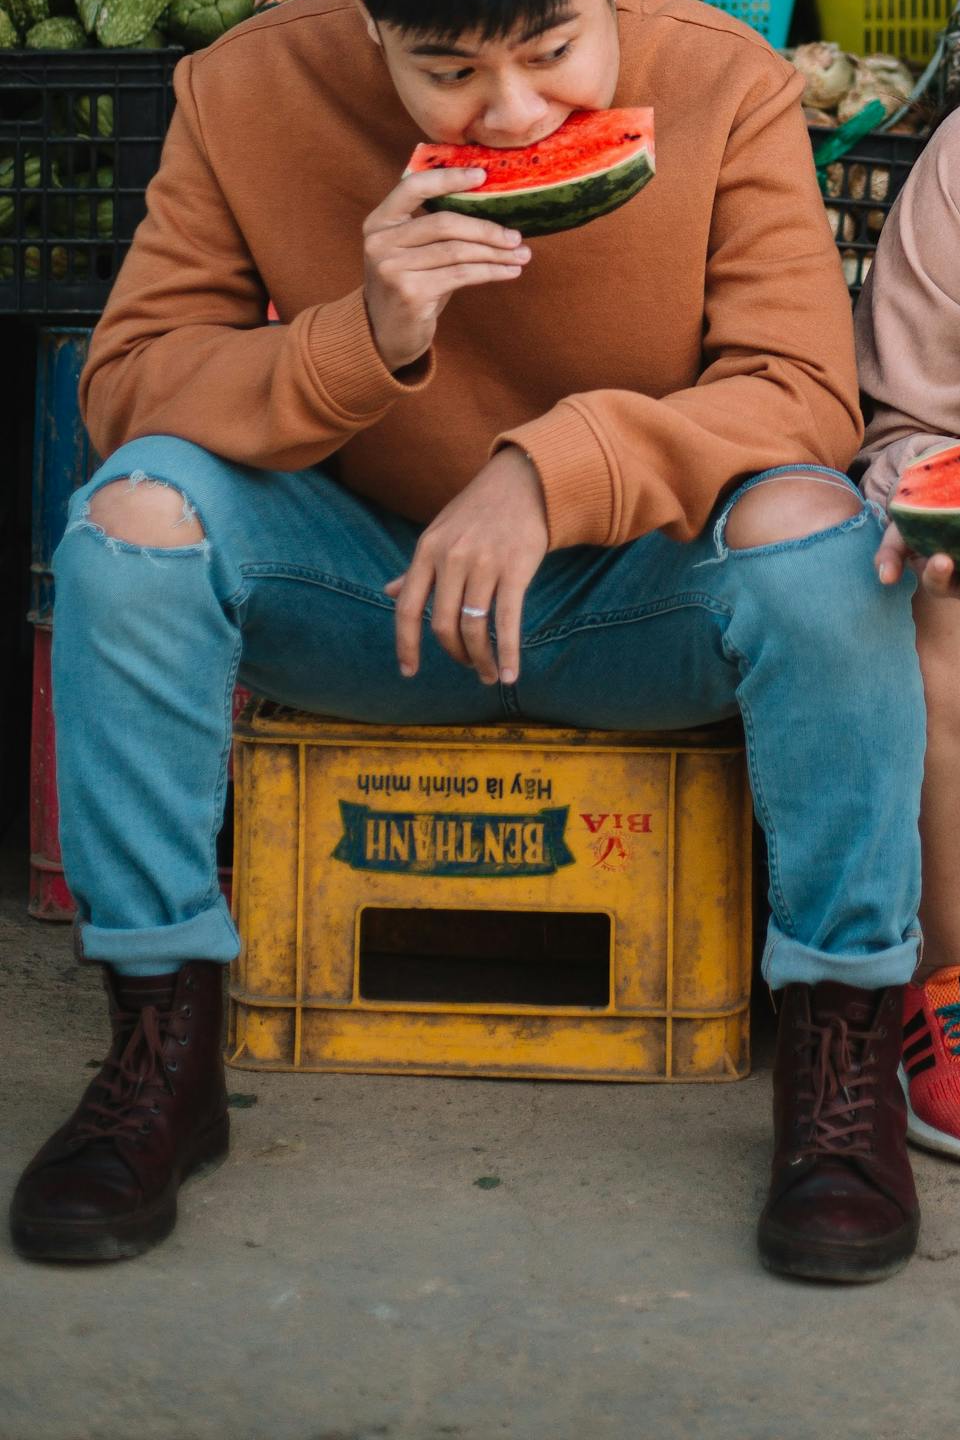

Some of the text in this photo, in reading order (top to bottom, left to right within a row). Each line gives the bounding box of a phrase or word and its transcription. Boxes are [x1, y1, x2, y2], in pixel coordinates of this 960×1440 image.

[357, 773, 552, 801] Hãy là chính mình
